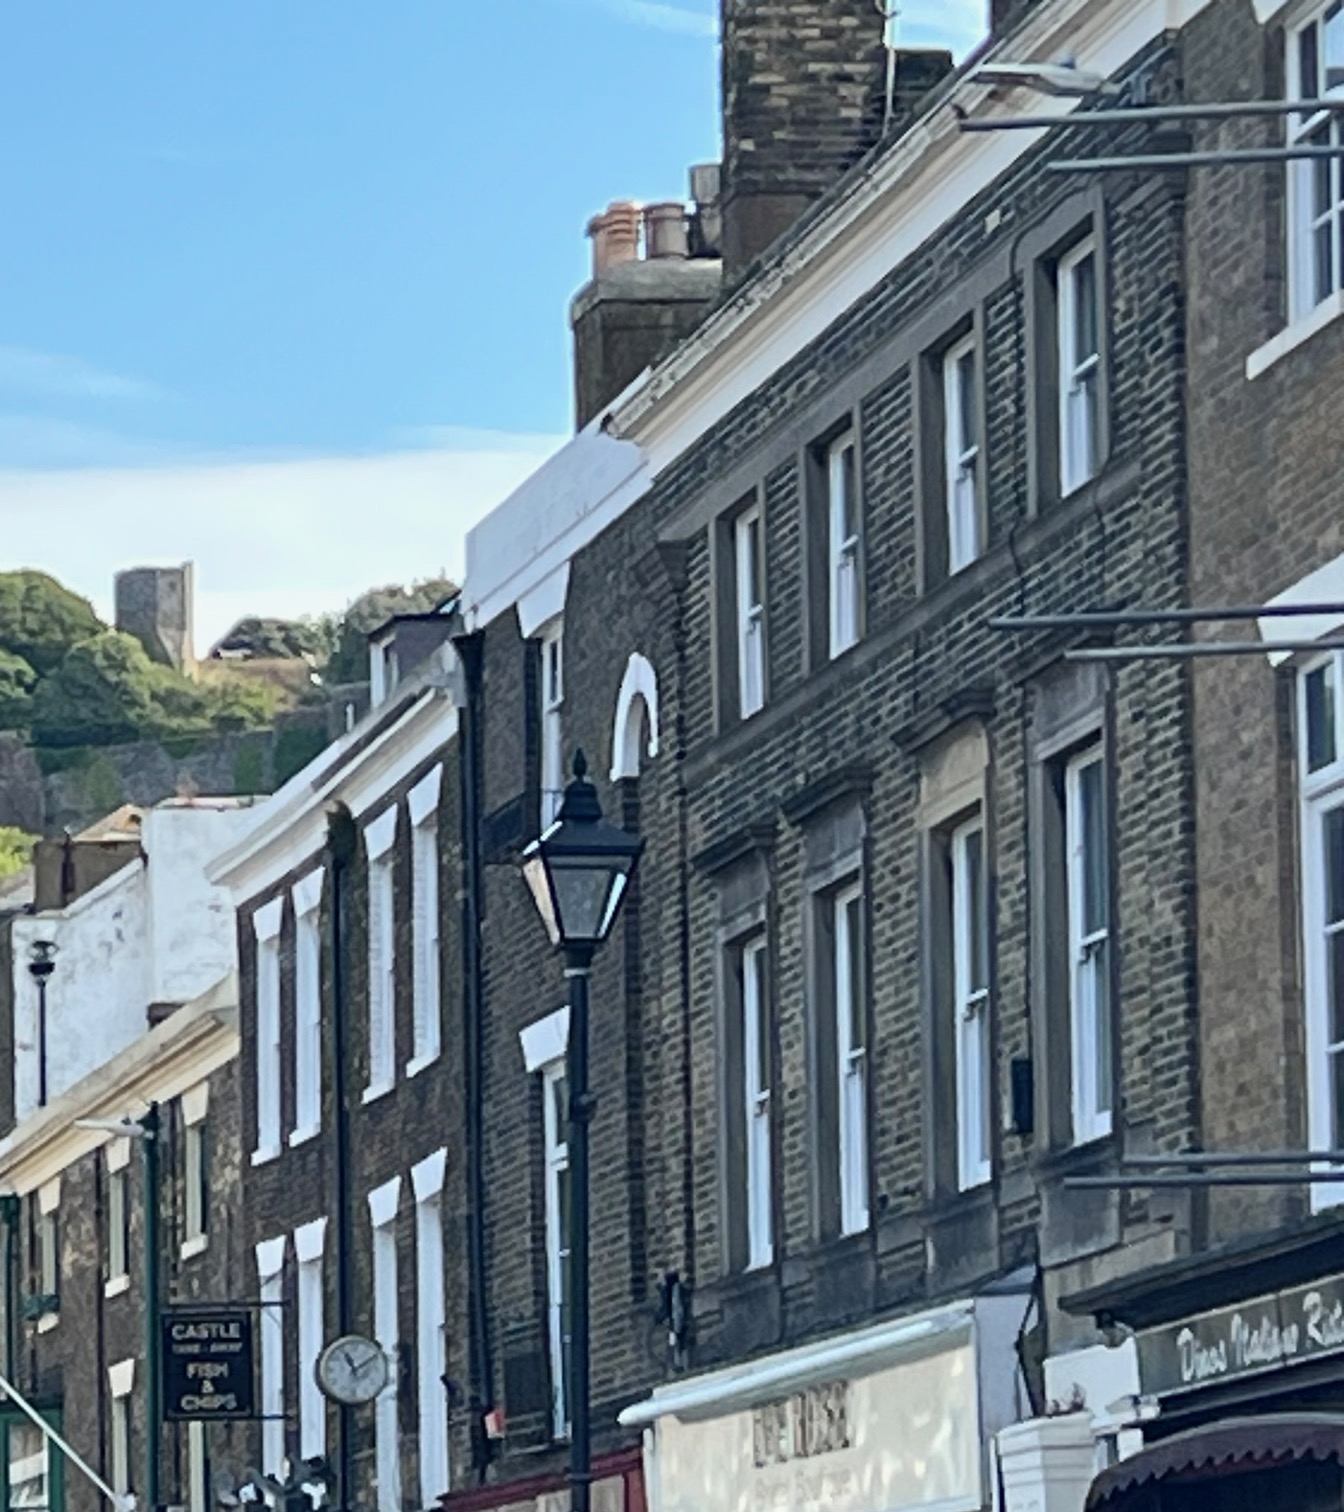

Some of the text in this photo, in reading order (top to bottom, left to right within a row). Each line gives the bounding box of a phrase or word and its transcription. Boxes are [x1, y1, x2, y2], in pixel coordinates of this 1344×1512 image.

[171, 1322, 241, 1340] CASTLE
[186, 1362, 229, 1379] FISH
[180, 1392, 238, 1411] CHIPS
